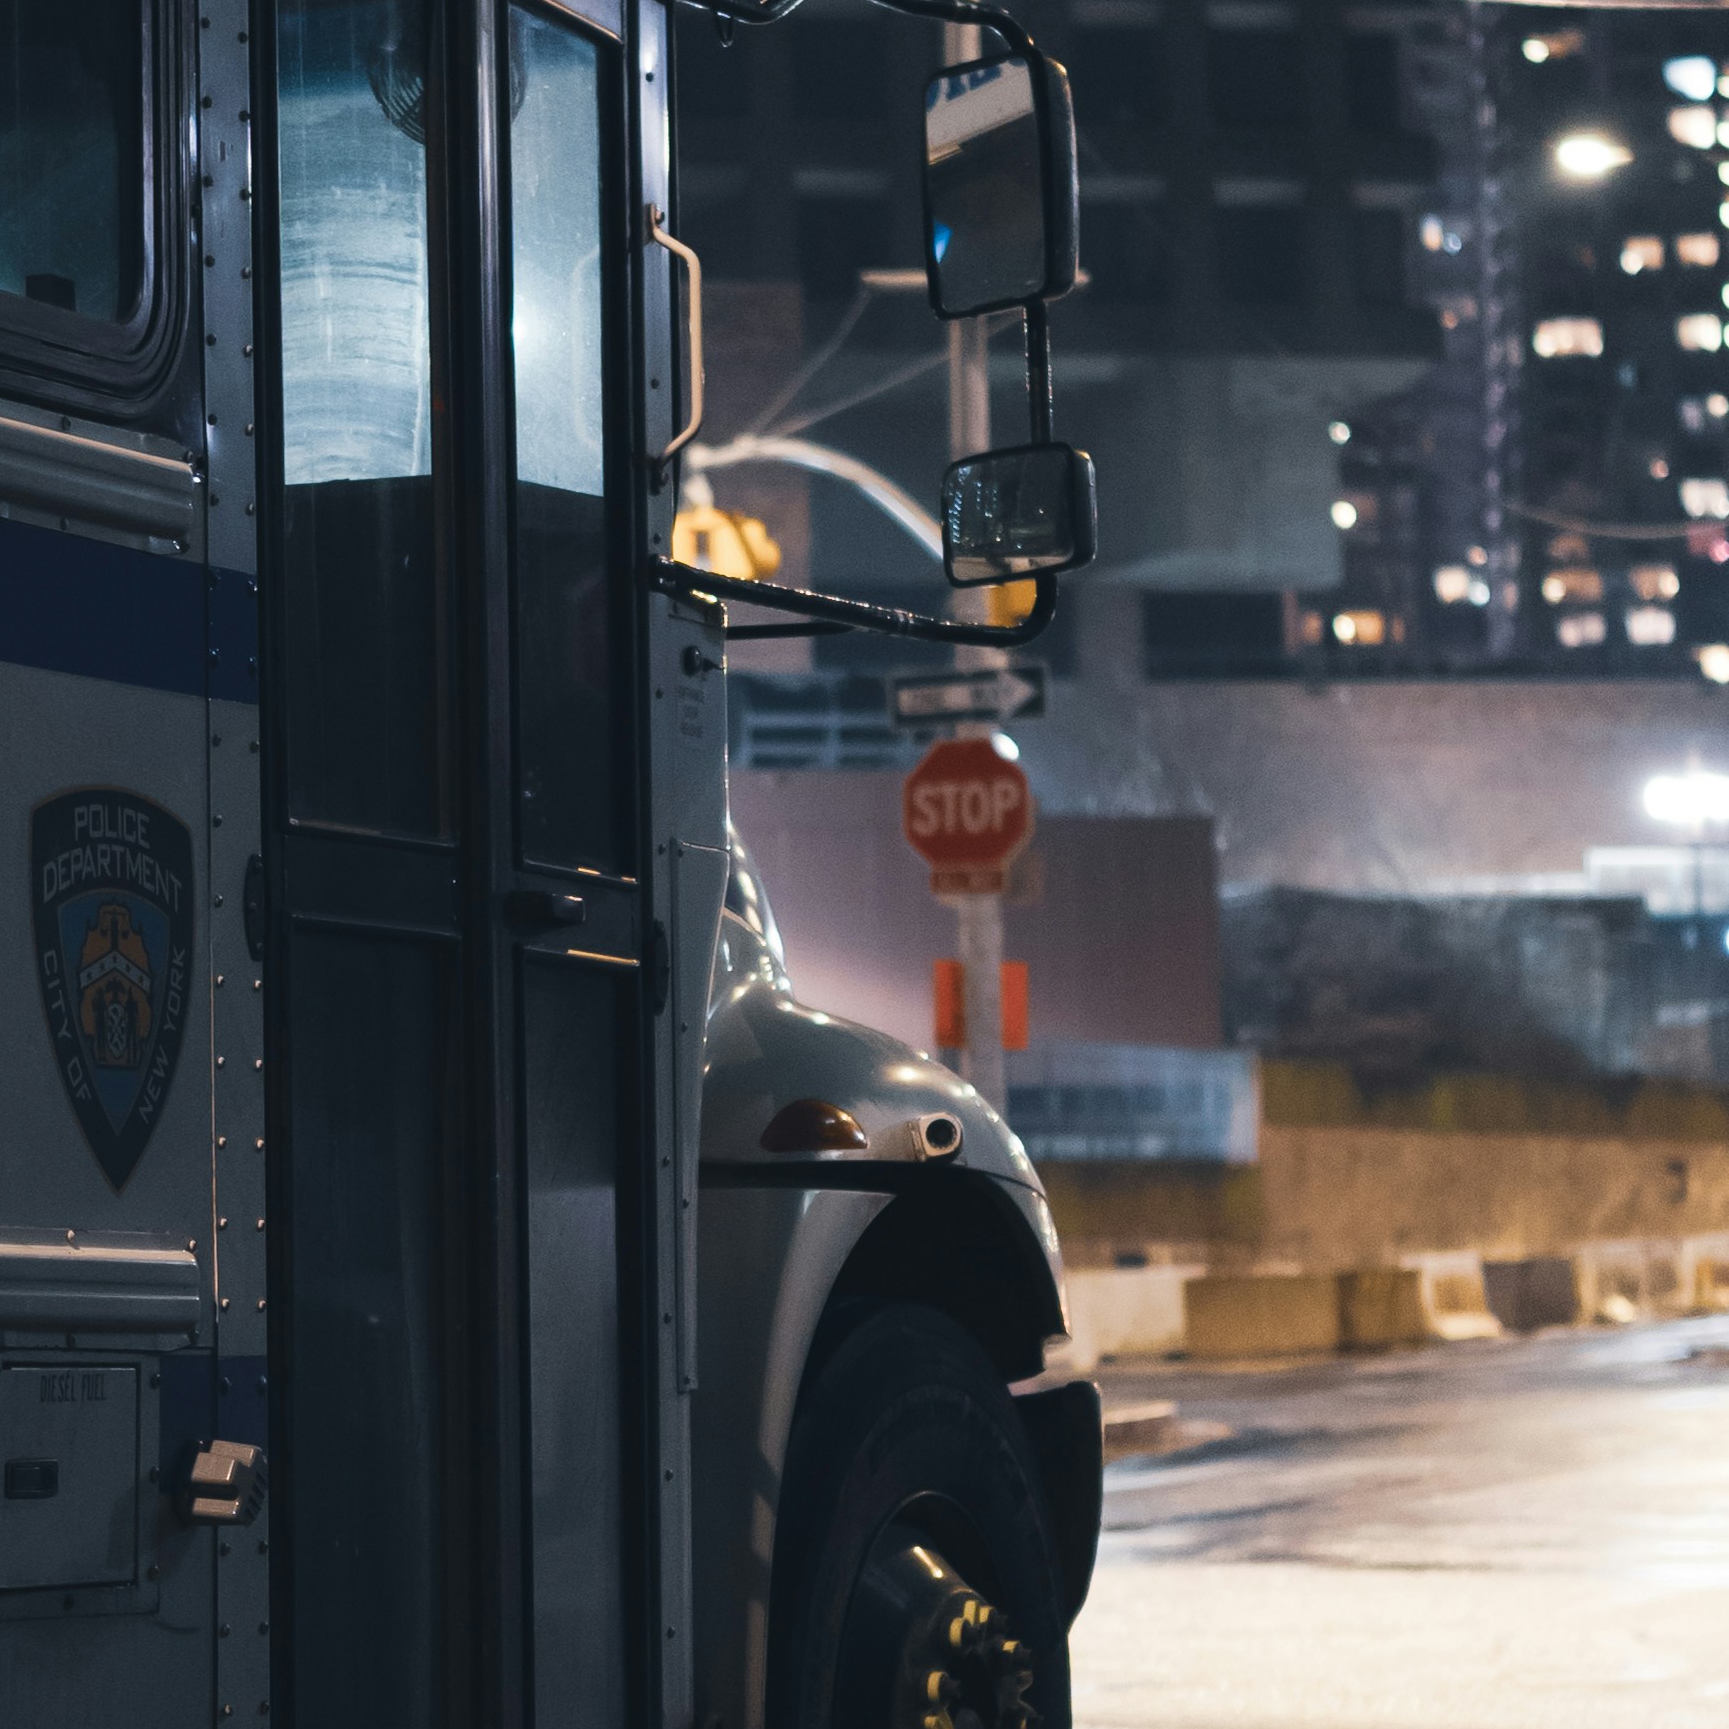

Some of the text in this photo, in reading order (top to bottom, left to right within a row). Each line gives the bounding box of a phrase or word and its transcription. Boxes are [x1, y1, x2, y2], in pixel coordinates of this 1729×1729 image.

[74, 804, 151, 849] POLICE
[911, 777, 1021, 837] STOP
[43, 843, 182, 913] DEPARTMENT
[44, 947, 186, 1125] CITY OF NEW YORK
[39, 1372, 107, 1403] DIESEL FUEL
